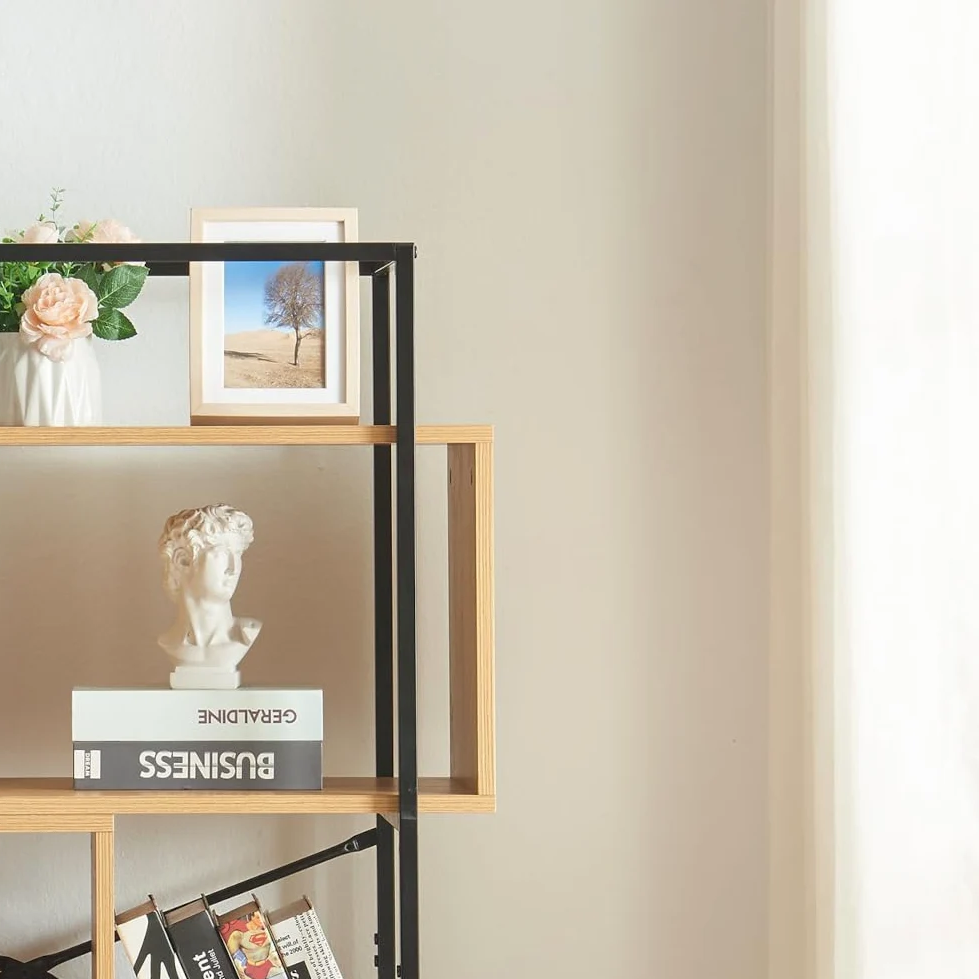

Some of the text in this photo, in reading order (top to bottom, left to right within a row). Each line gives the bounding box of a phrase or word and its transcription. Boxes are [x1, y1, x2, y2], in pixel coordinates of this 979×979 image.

[198, 709, 297, 724] GERALDINE
[139, 750, 275, 780] BUSINESS
[208, 948, 220, 969] Juliet
